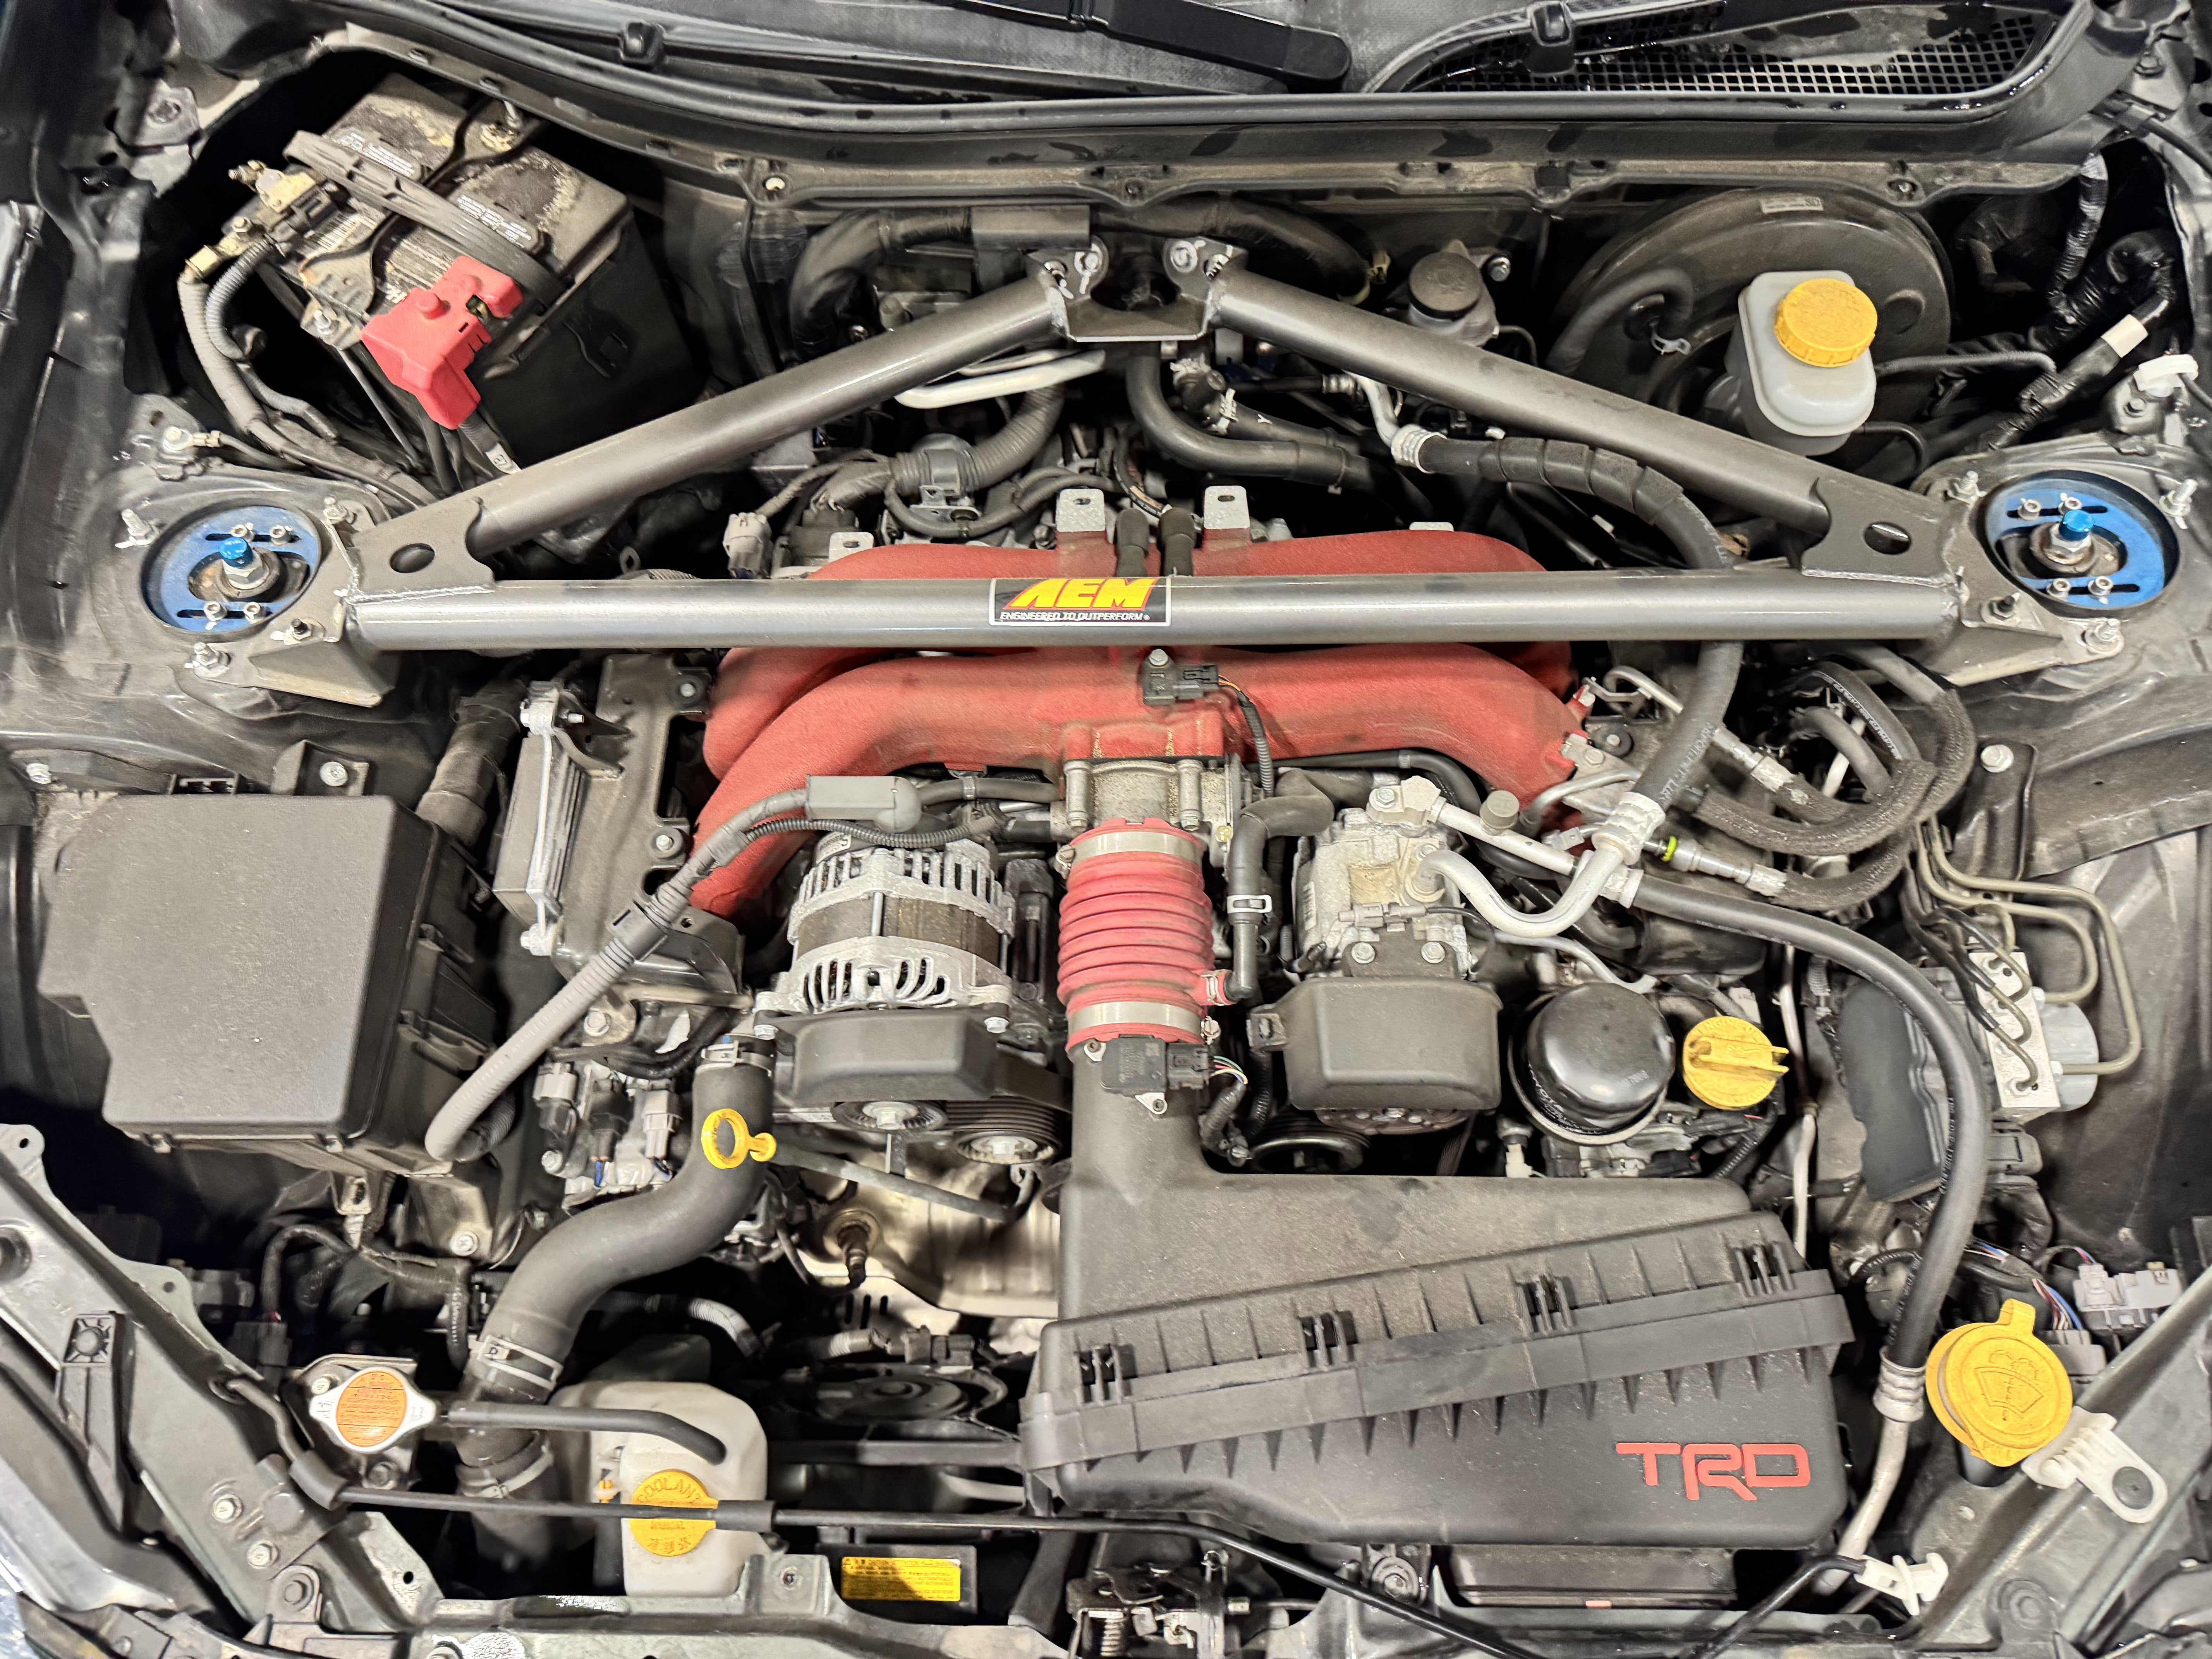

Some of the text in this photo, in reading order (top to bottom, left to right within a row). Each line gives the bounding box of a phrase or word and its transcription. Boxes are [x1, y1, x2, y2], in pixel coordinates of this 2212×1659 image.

[1003, 579, 1159, 611] AEM
[1000, 612, 1061, 621] ENGINEERED
[1062, 612, 1077, 621] TO
[1616, 1442, 1811, 1501] TRD
[637, 1477, 701, 1503] COOLANT
